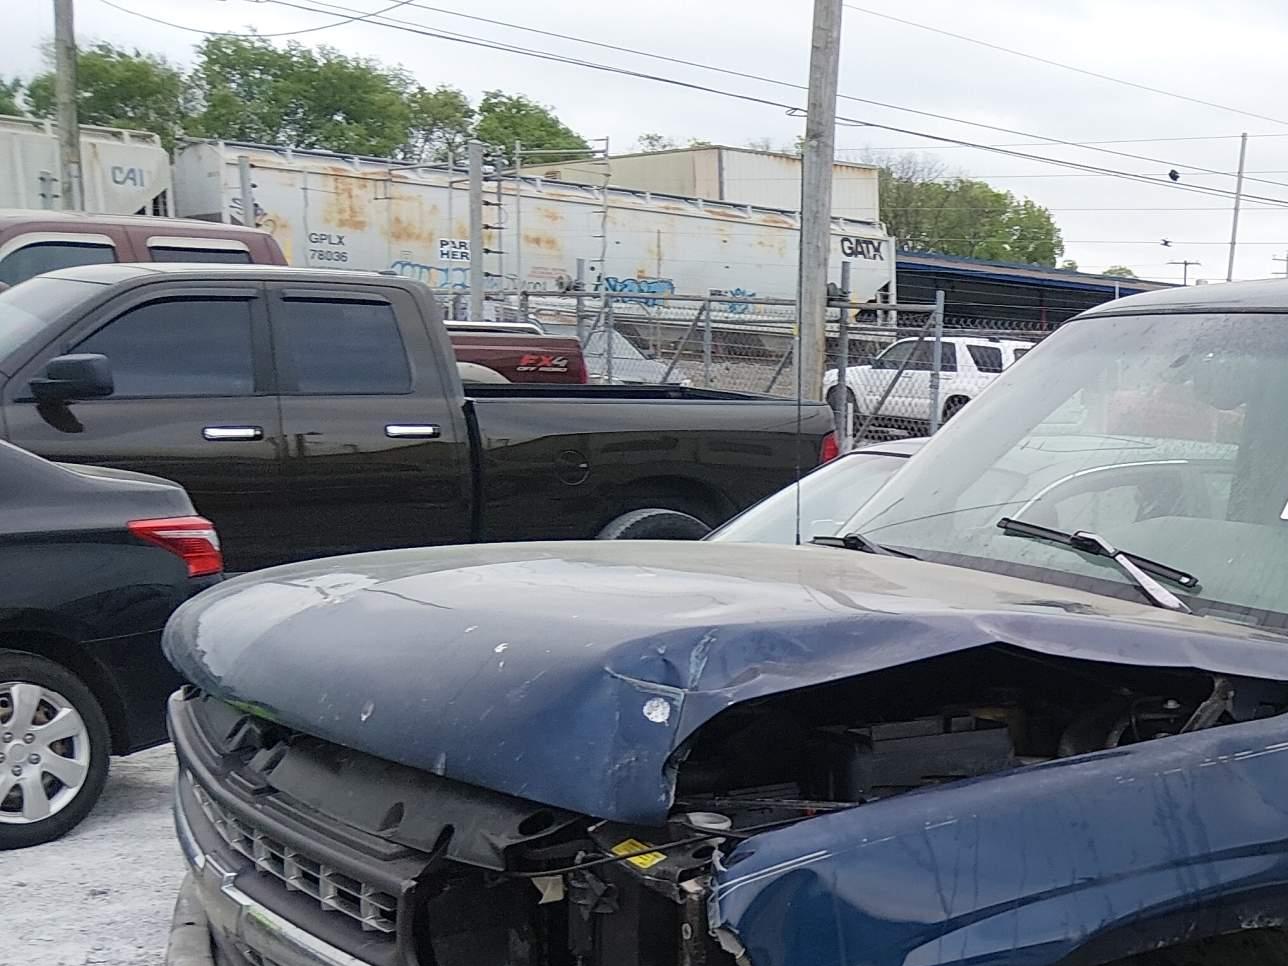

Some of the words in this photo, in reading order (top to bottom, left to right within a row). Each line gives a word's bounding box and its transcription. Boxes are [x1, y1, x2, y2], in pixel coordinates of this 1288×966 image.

[308, 232, 345, 246] GPLX
[440, 239, 471, 250] PAR
[440, 249, 471, 260] HER
[840, 237, 884, 261] GATX
